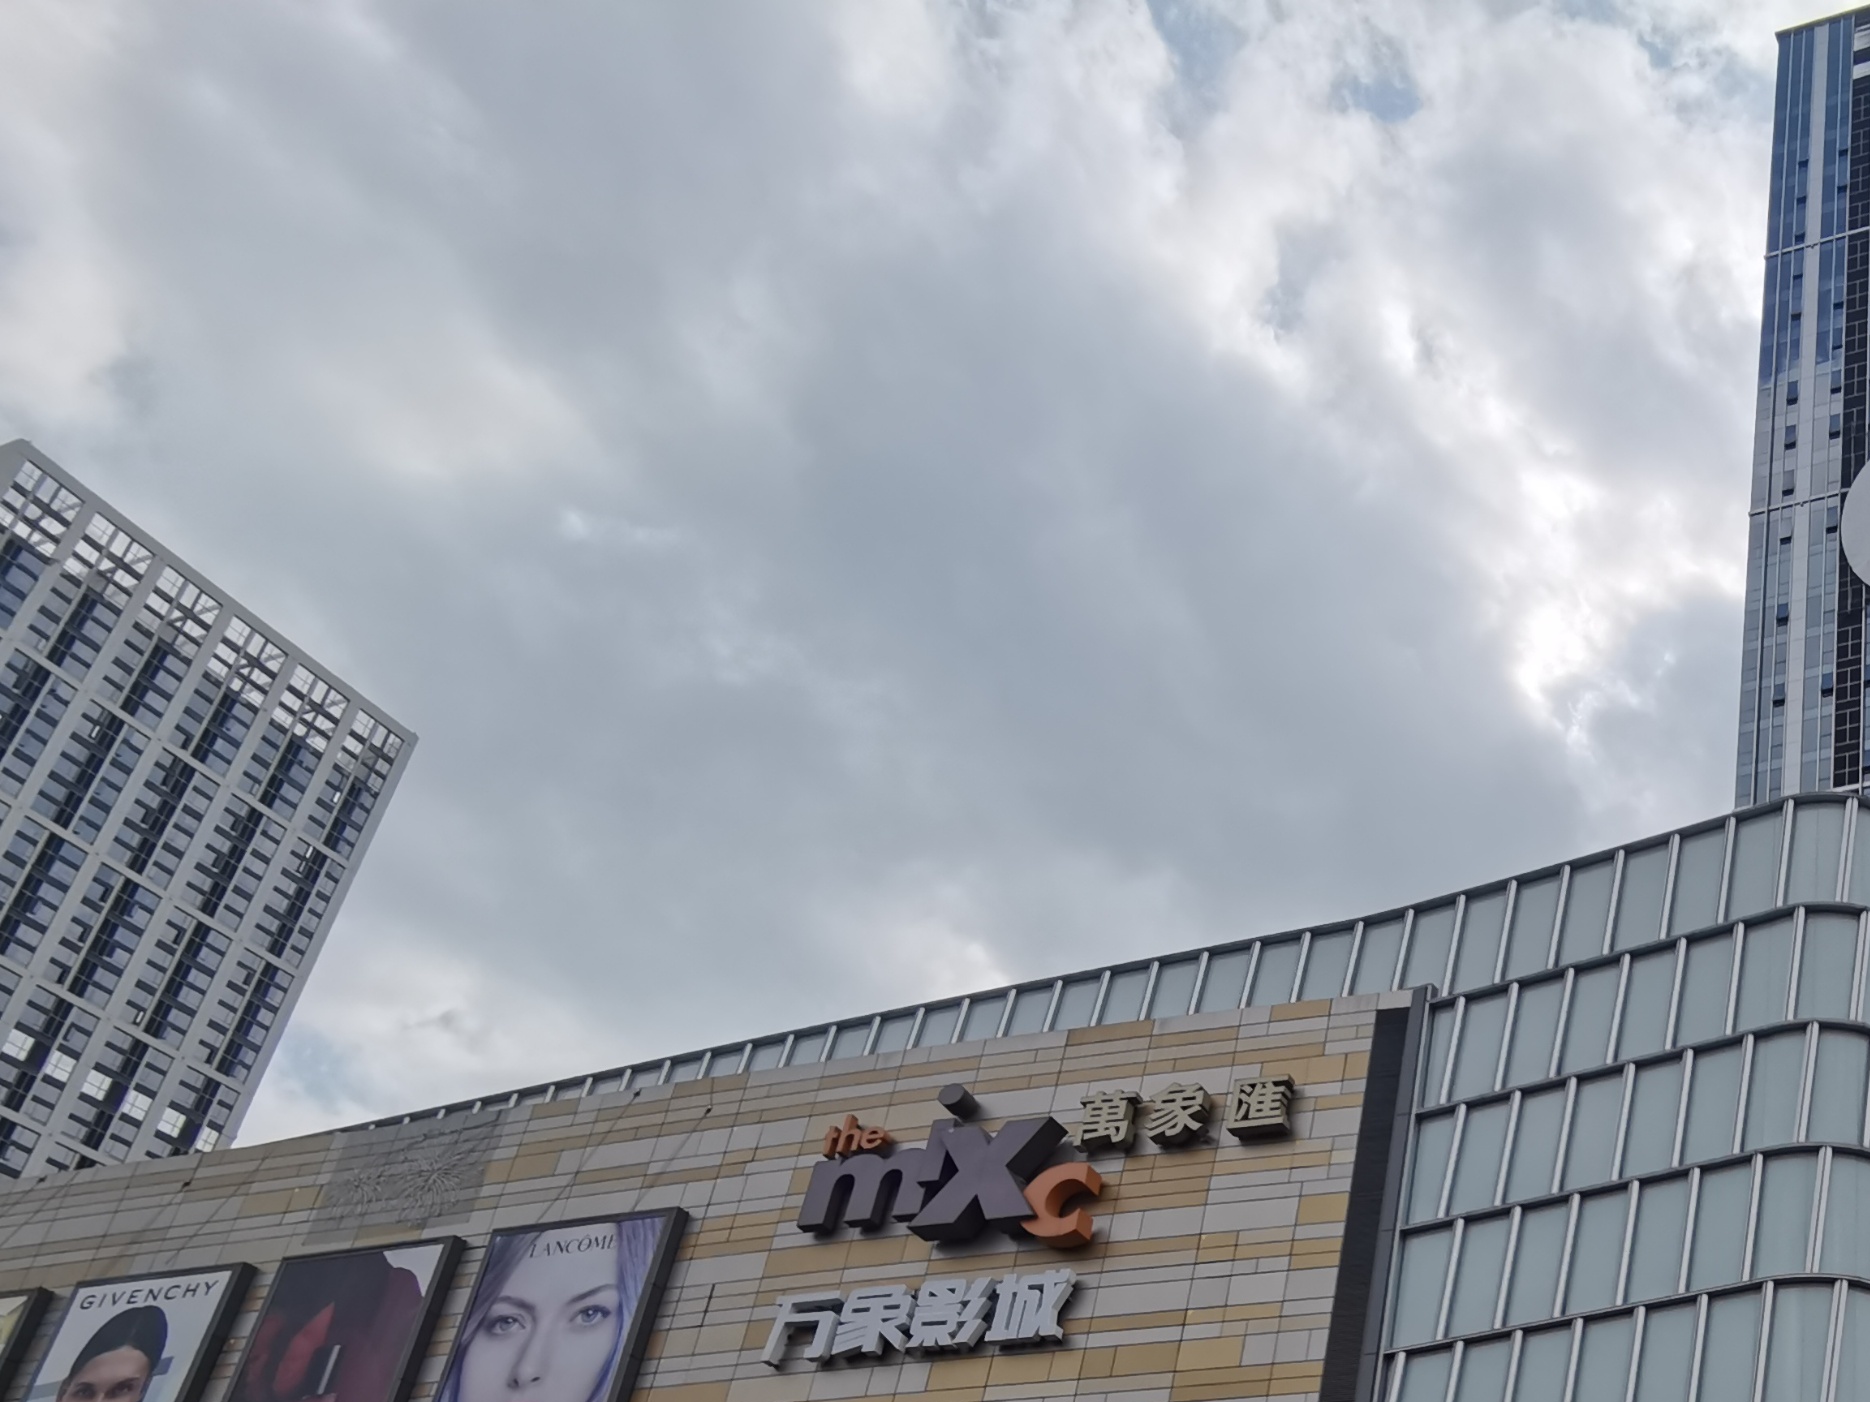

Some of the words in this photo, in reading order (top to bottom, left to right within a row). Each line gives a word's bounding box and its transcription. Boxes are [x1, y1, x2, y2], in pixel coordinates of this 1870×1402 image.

[823, 1114, 894, 1160] the
[1074, 1074, 1296, 1152] 萬象匯
[80, 1280, 219, 1310] GIVENCHY
[761, 1268, 1077, 1367] 万象影城
